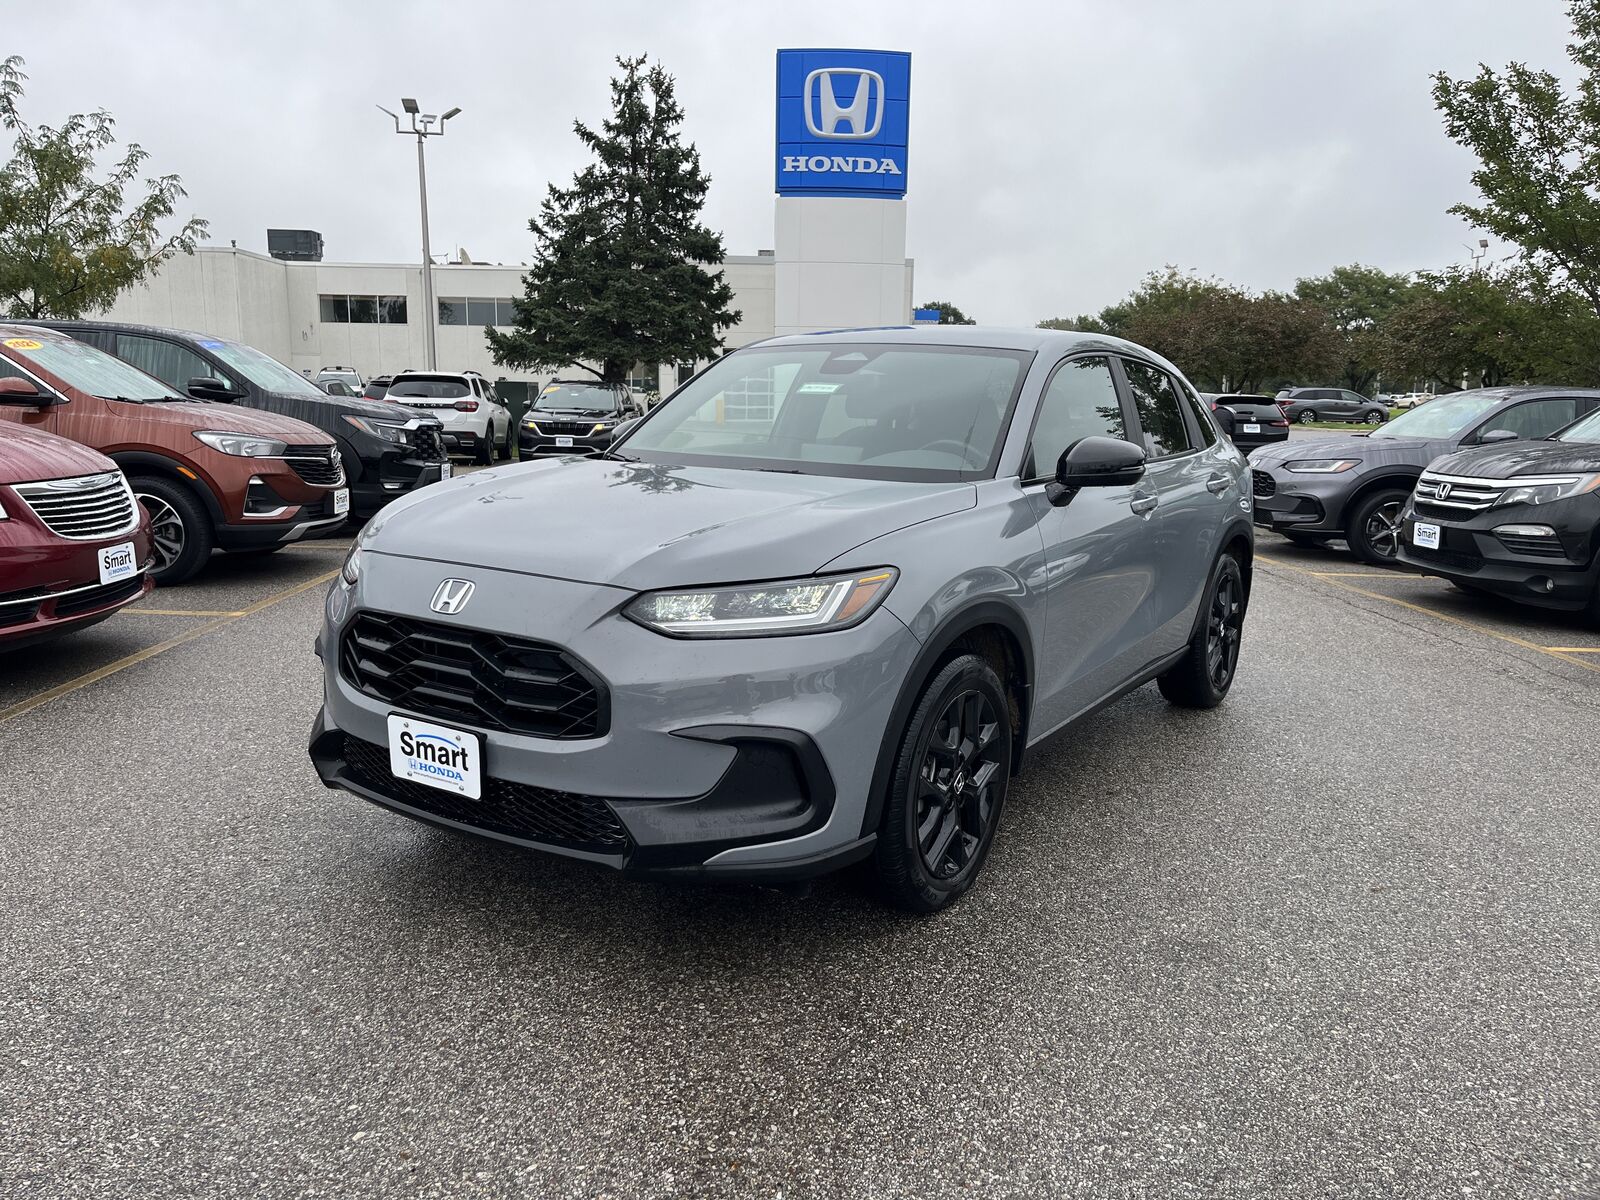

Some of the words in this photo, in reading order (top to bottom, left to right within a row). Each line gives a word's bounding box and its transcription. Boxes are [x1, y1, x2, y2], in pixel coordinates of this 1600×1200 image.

[783, 156, 902, 174] HONDA
[1417, 528, 1436, 540] Smart
[104, 551, 131, 570] Smart
[111, 566, 131, 575] HONDA
[400, 731, 469, 772] Smart
[418, 762, 465, 782] HONDA
